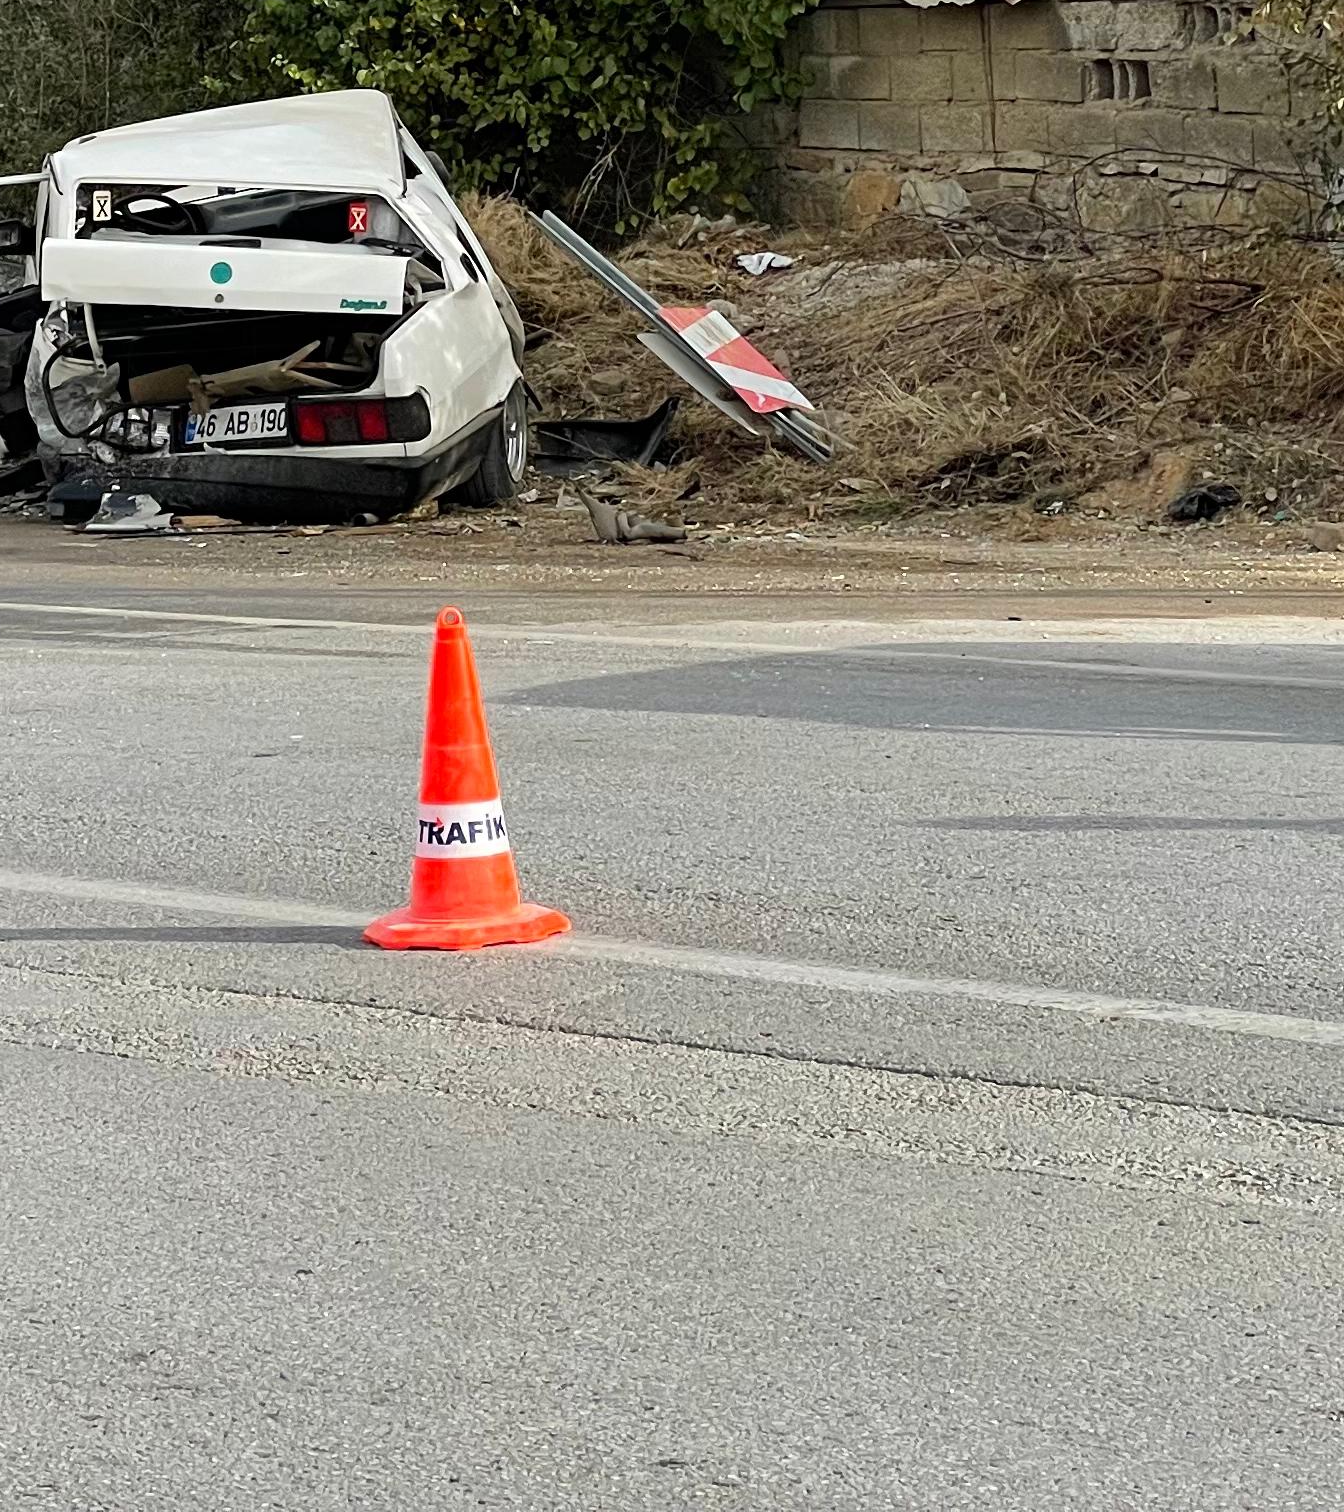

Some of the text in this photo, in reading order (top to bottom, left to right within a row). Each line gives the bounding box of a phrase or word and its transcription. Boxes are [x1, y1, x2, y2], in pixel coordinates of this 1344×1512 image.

[196, 408, 287, 438] 46 AB 190
[418, 813, 506, 845] TRAFİK
